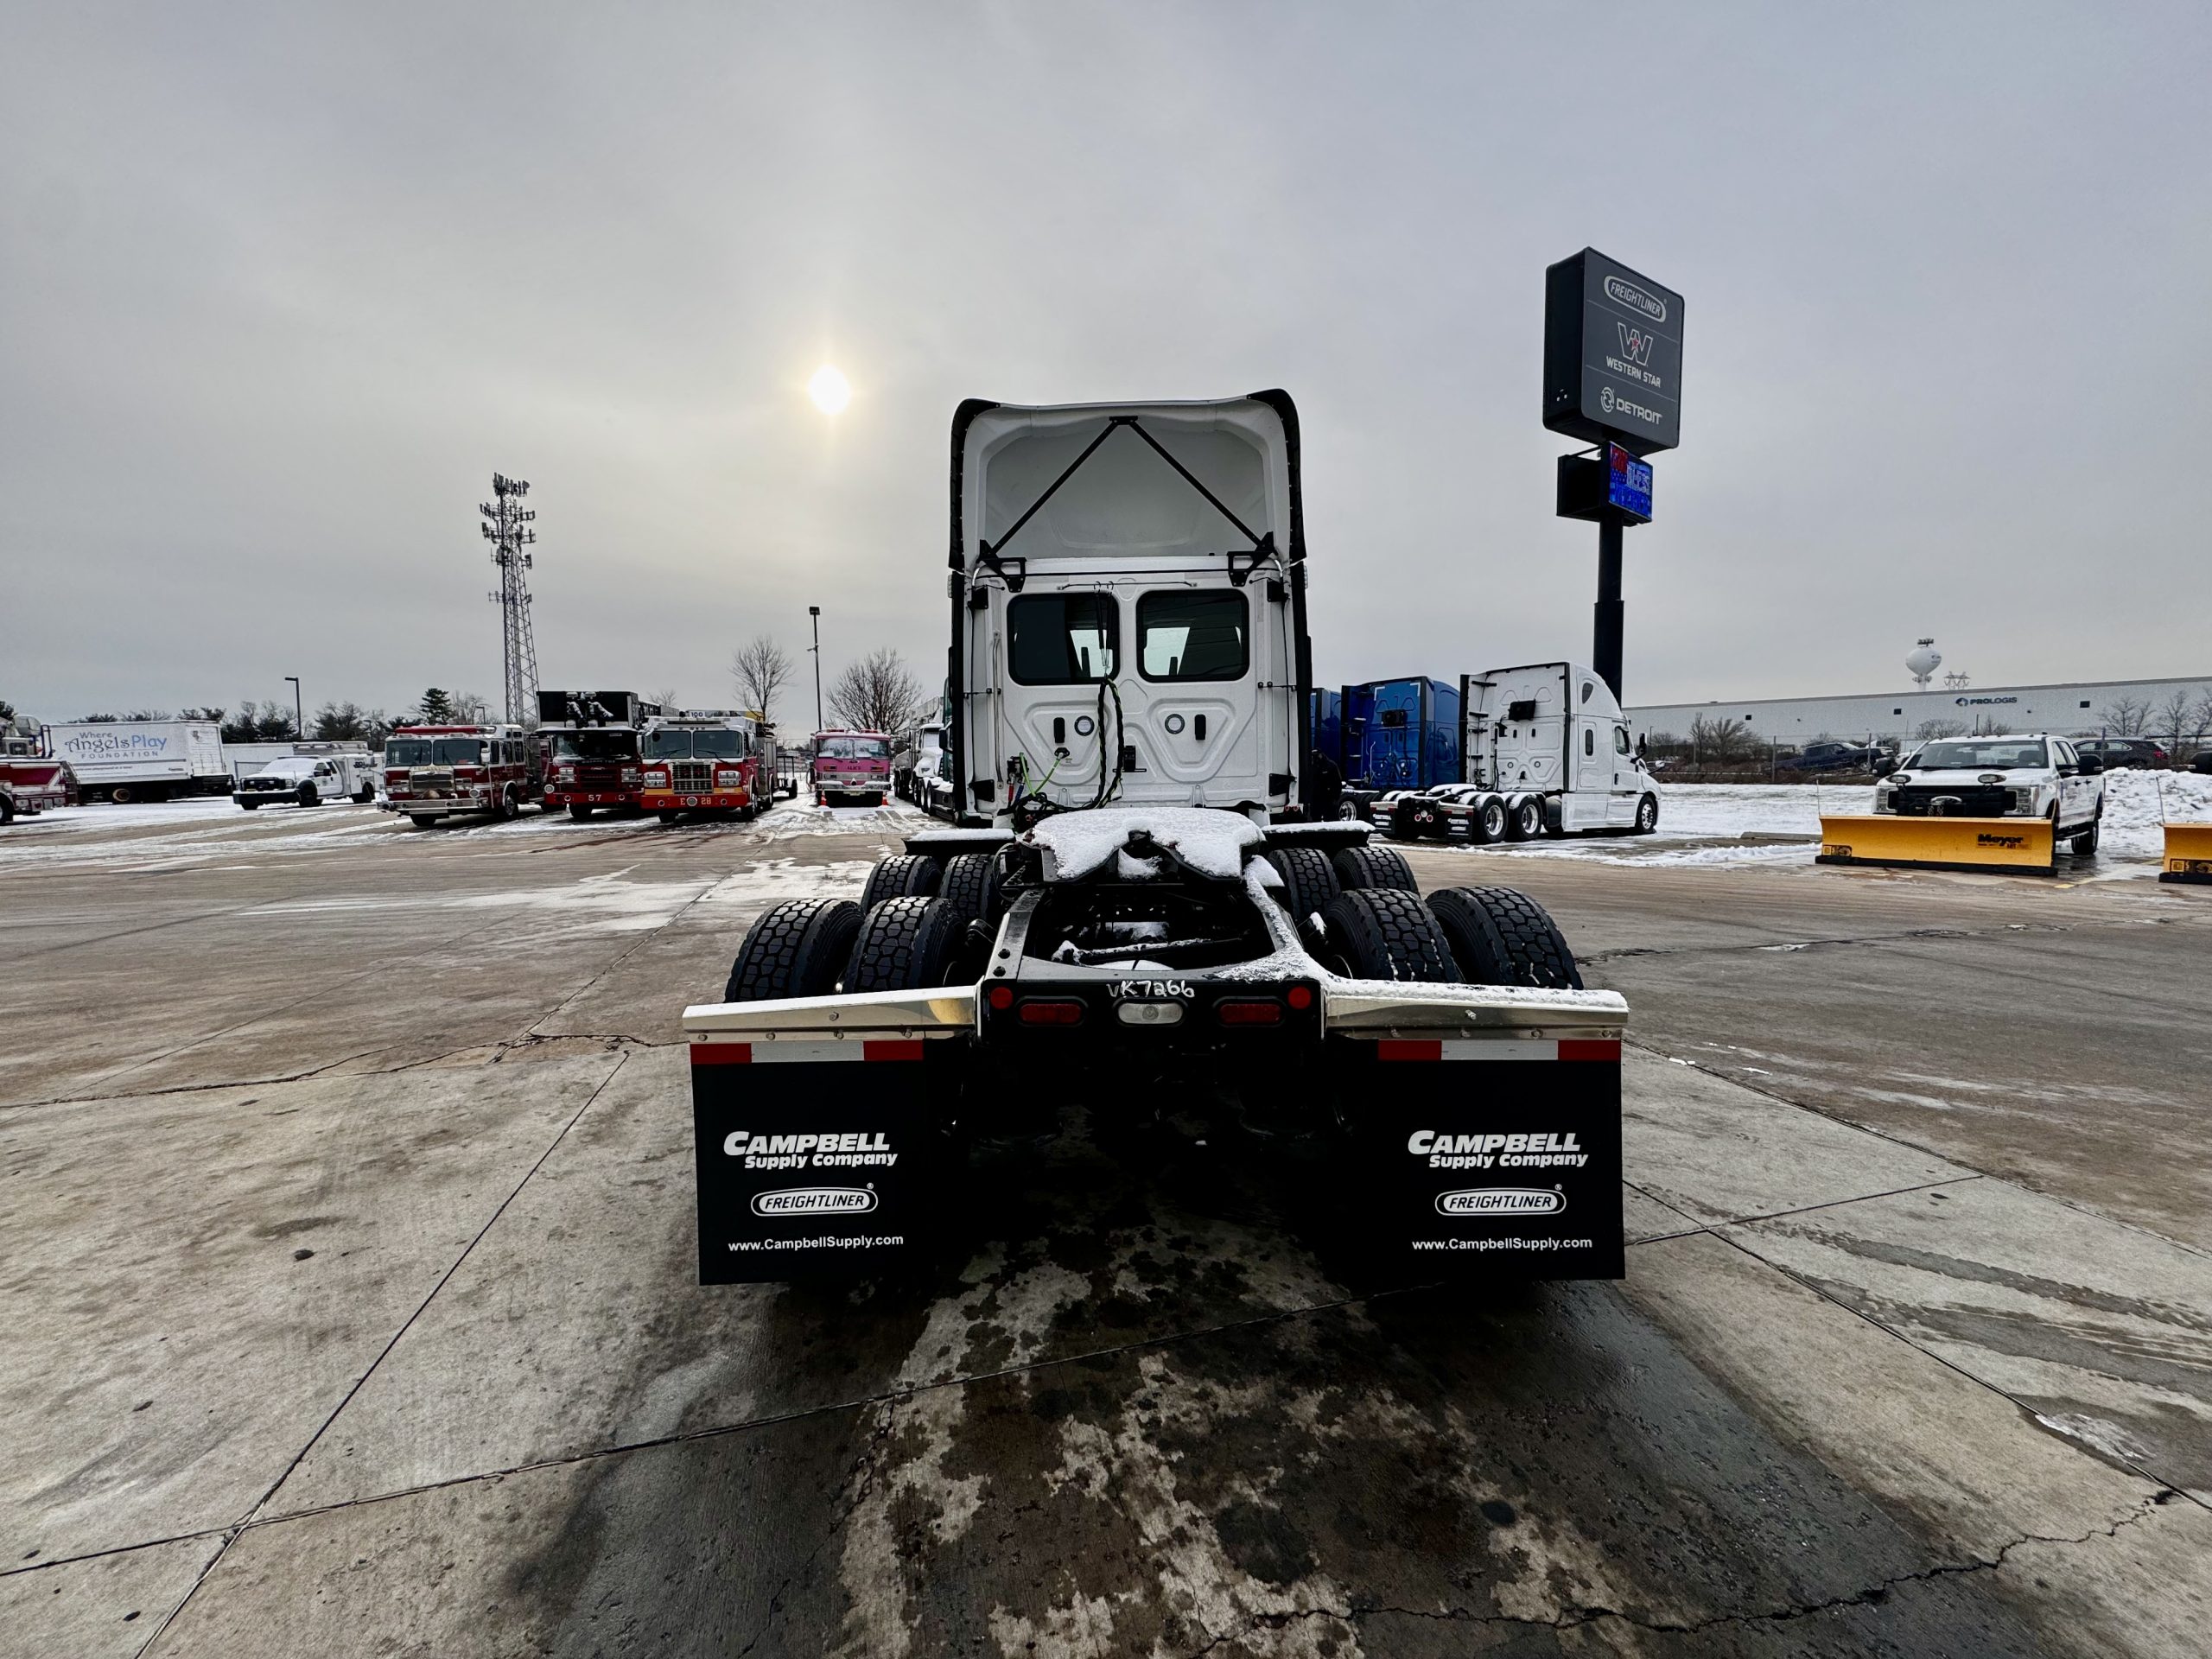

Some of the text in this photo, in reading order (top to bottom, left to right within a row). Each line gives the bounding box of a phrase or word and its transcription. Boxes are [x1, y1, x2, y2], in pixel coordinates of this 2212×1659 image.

[1610, 282, 1662, 317] FREIGHTLINER
[1606, 355, 1662, 388] WESTERN STAR
[1616, 397, 1663, 424] DETROIT
[1969, 696, 2018, 705] PROLOGIS
[81, 751, 159, 760] FOUNDATION
[701, 797, 712, 805] 28
[1977, 833, 2024, 847] Meyer
[723, 1131, 890, 1155] CAMPBELL
[1408, 1129, 1581, 1154] CAMPBELL
[744, 1153, 899, 1170] Supply Company
[1428, 1154, 1589, 1169] Supply Company
[765, 1195, 865, 1210] FREIGHTLINER
[1449, 1195, 1553, 1209] FREIGHTLINER
[728, 1235, 904, 1251] www.CampbellSupply.com
[1412, 1236, 1593, 1251] www.CampbellSupply.com
